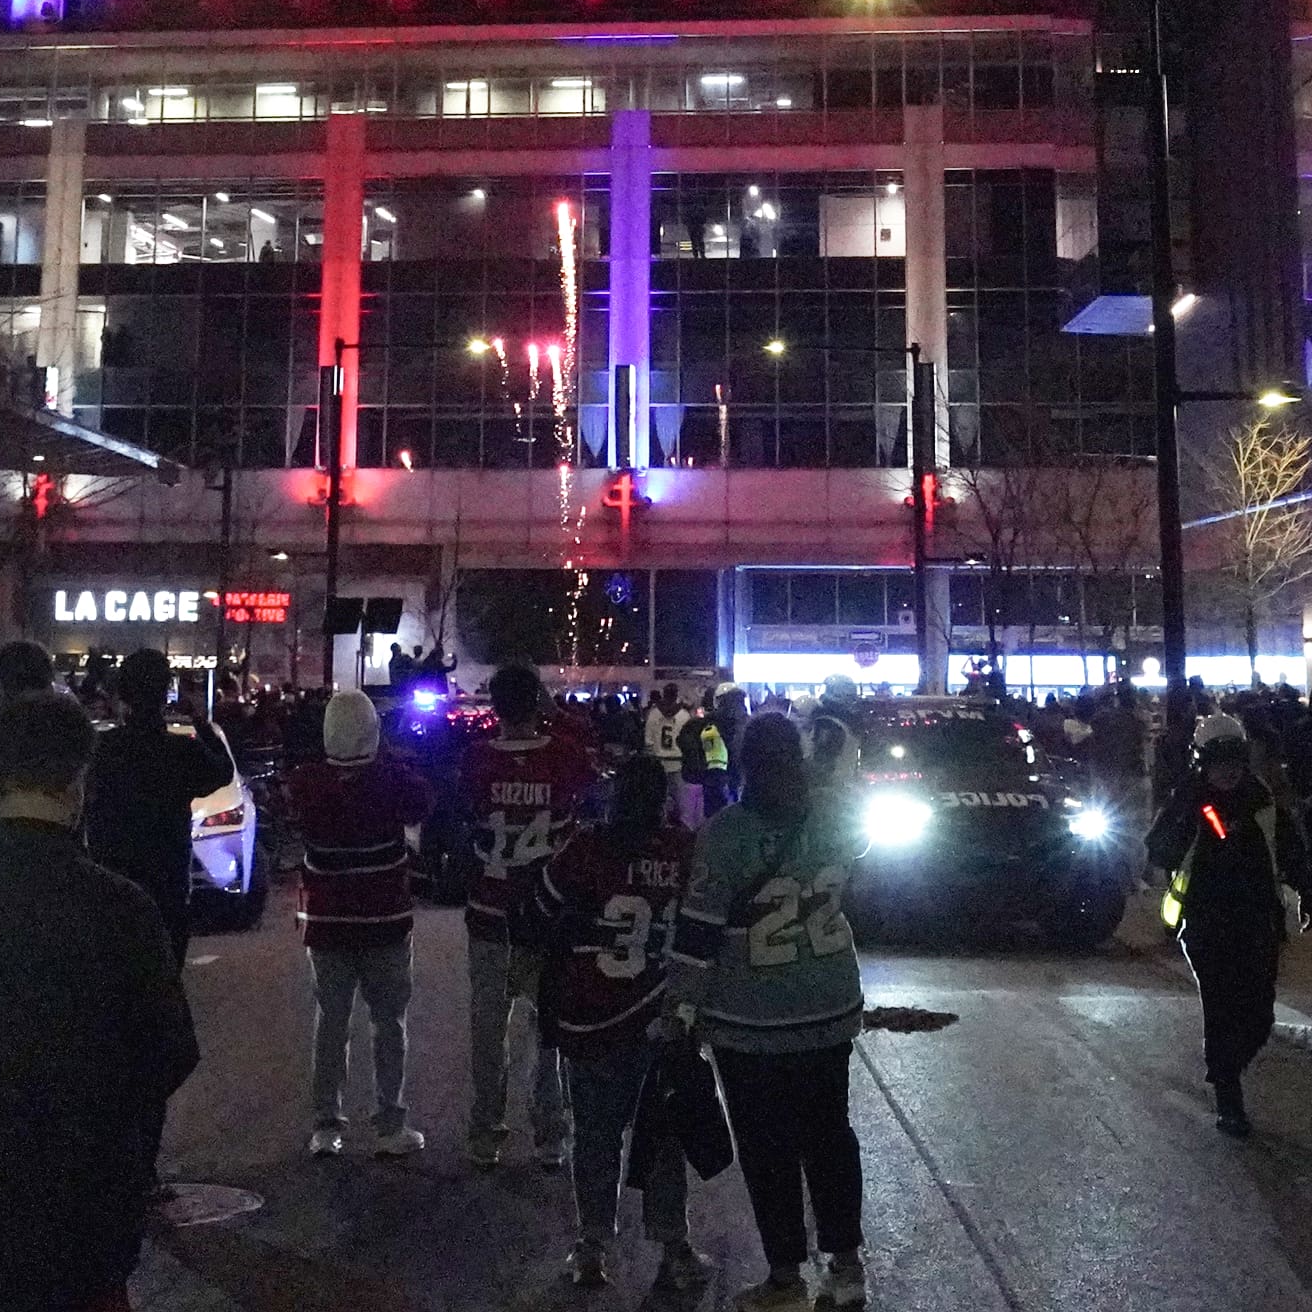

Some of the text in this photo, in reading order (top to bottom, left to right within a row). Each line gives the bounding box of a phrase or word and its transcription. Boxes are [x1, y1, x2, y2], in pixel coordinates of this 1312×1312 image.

[54, 590, 200, 622] LA CAGE
[490, 782, 552, 807] SUZUKI
[484, 809, 557, 880] 14
[748, 866, 855, 967] 22
